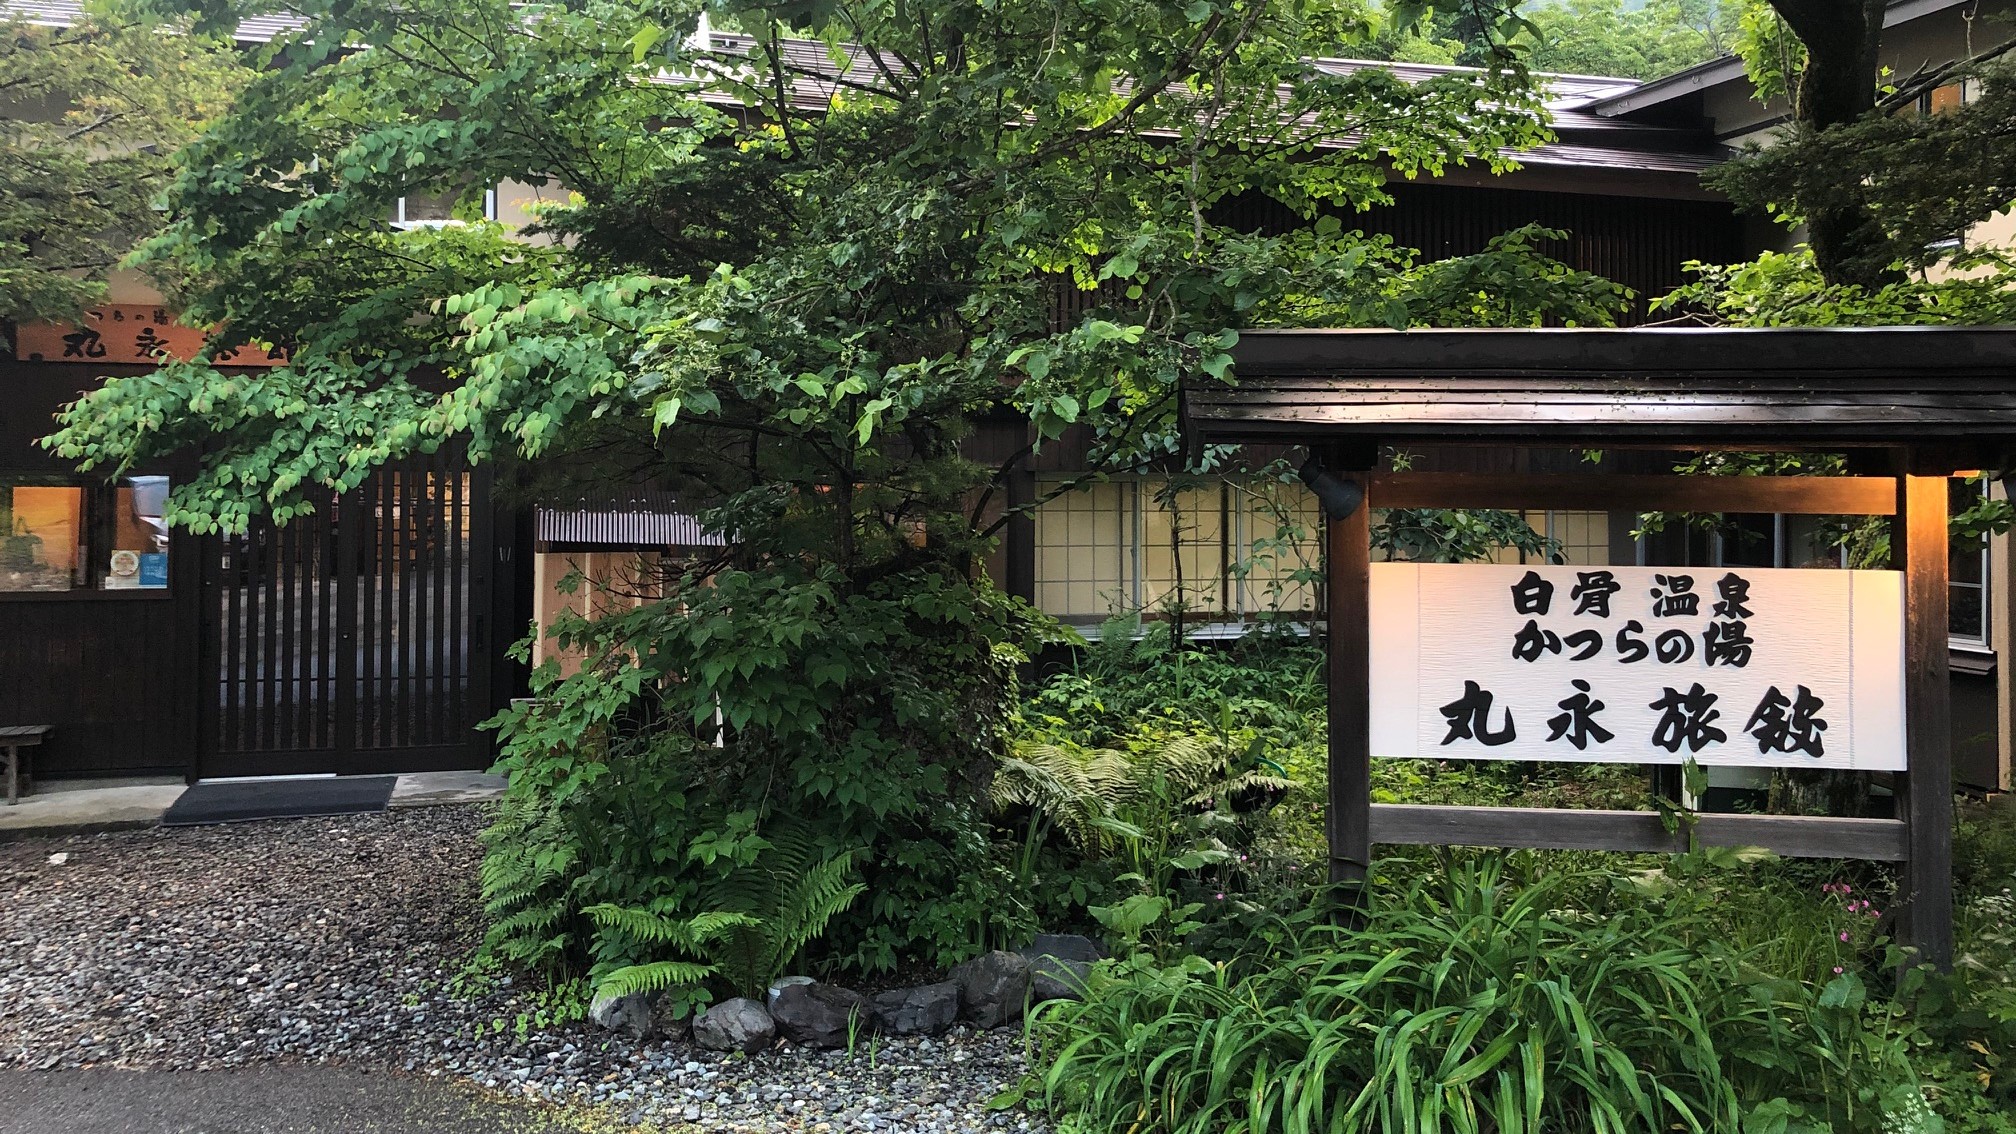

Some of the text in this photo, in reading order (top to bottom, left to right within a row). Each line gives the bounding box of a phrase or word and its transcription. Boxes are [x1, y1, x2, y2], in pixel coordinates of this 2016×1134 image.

[84, 308, 168, 325] つらの湯
[1510, 570, 1755, 619] 白骨温泉
[1512, 619, 1755, 667] かつらの湯
[1439, 679, 1828, 758] 丸永旅館
